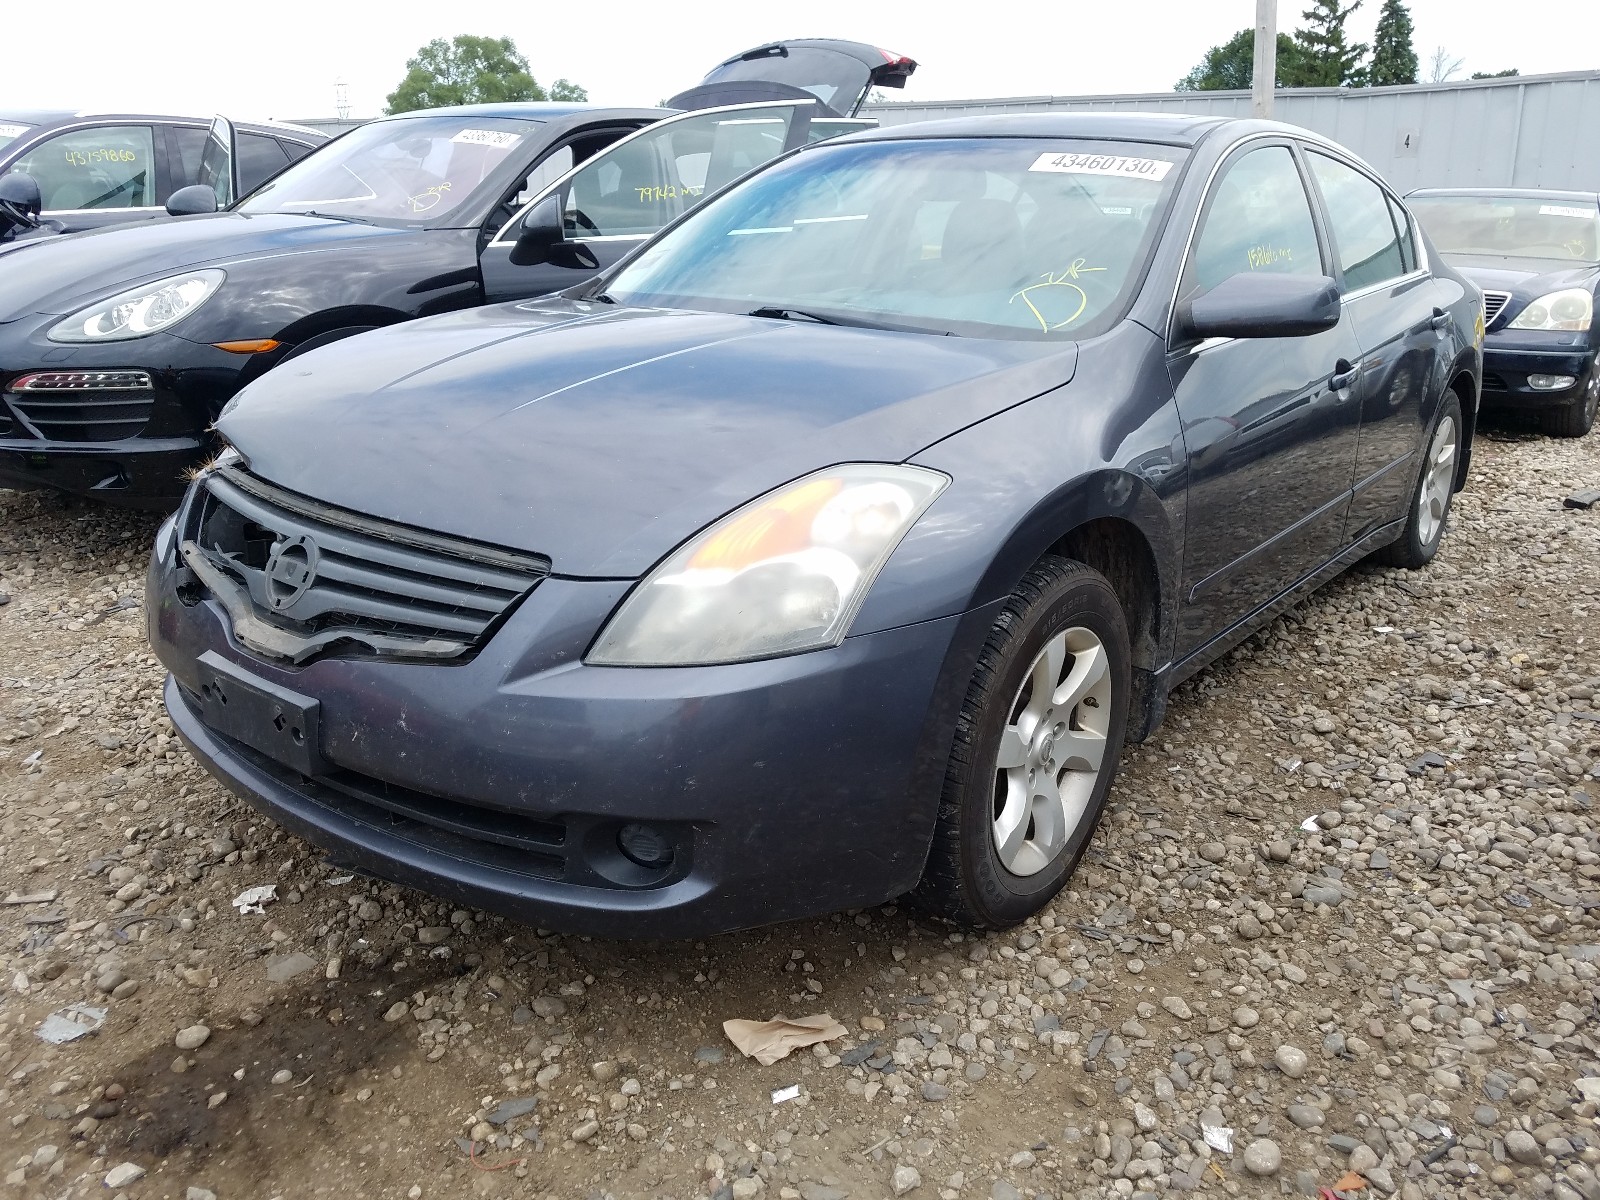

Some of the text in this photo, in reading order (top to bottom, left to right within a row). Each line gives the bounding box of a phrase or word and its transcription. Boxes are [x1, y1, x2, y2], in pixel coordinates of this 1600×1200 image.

[1404, 134, 1411, 148] 4
[65, 148, 136, 167] 43759860
[1051, 154, 1153, 174] 43460130
[634, 184, 677, 203] 79742
